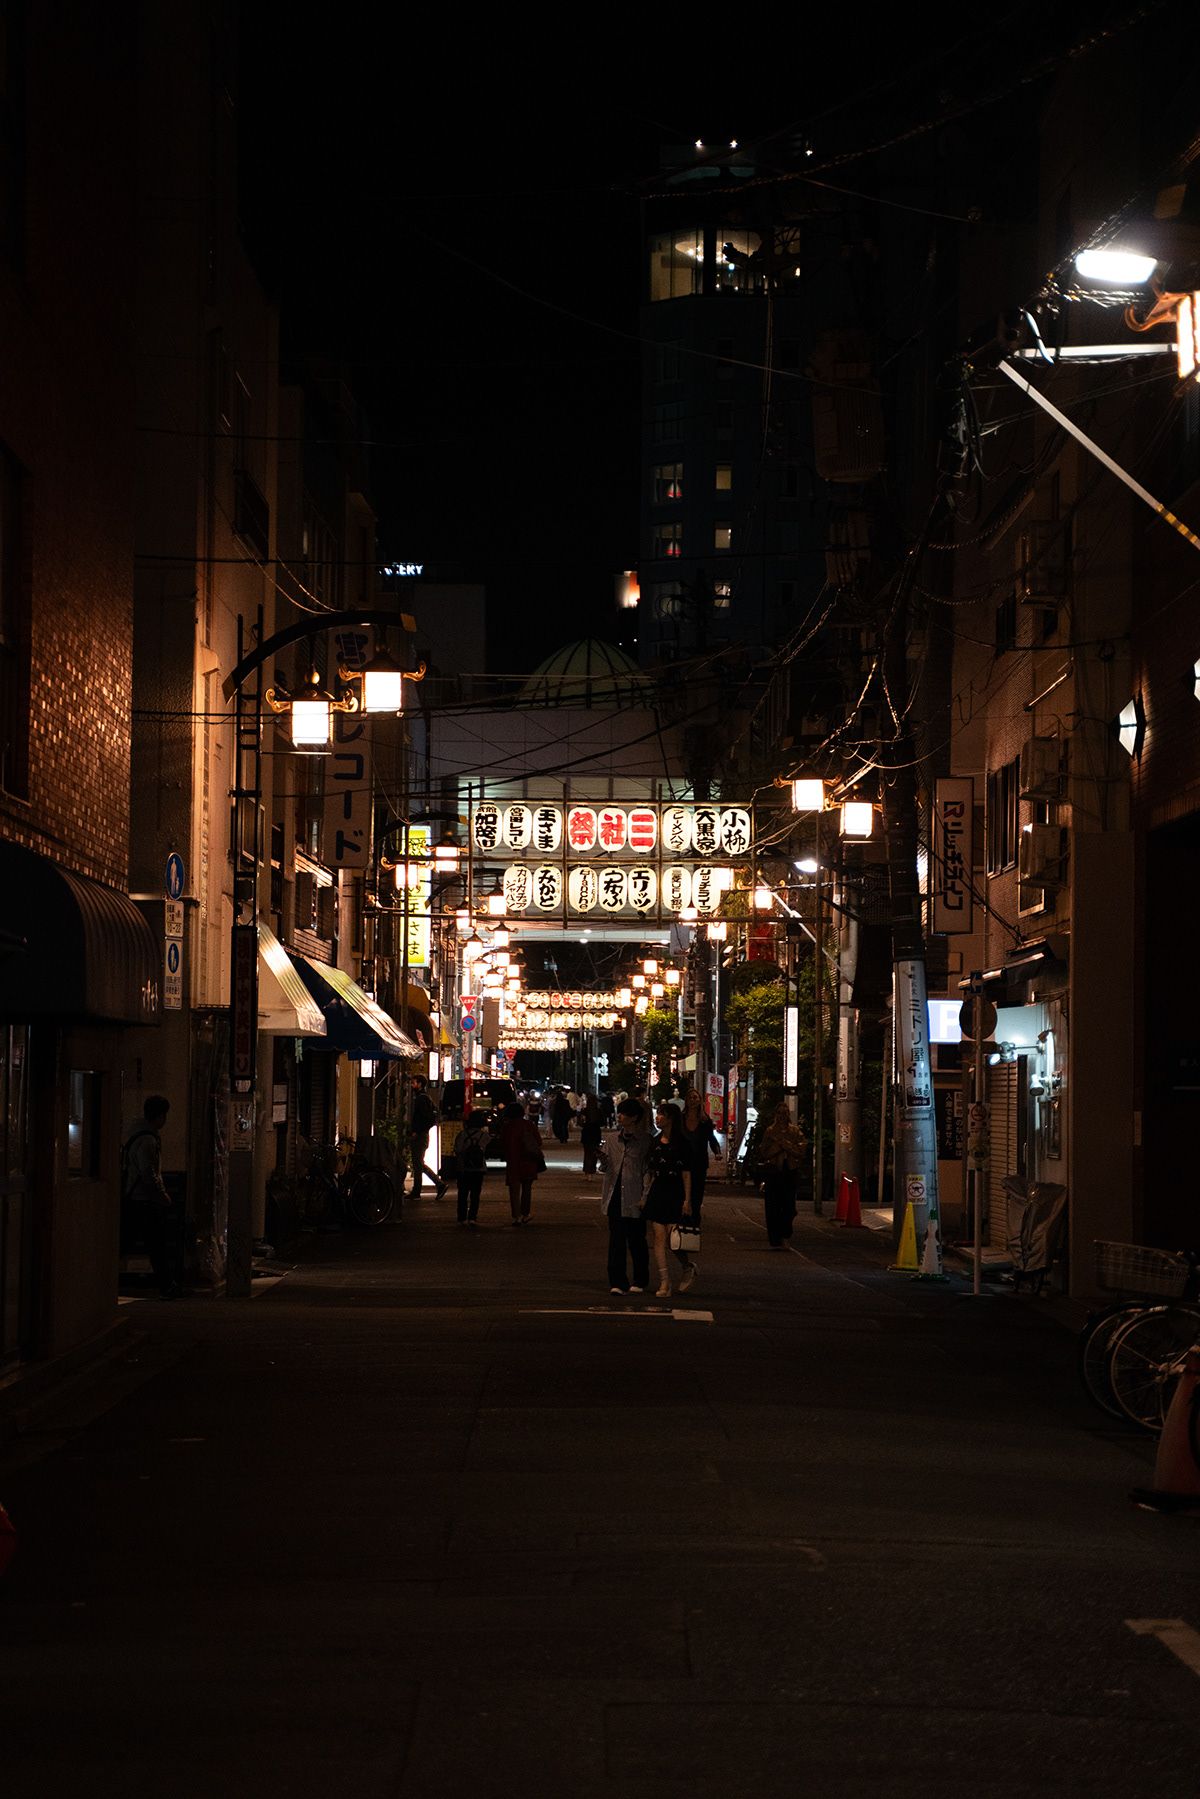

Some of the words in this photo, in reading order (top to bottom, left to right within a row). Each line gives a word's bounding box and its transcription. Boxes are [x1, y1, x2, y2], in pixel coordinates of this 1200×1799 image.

[696, 810, 716, 850] 大黒家
[723, 811, 746, 852] 小柳
[632, 870, 651, 907] エリッツ
